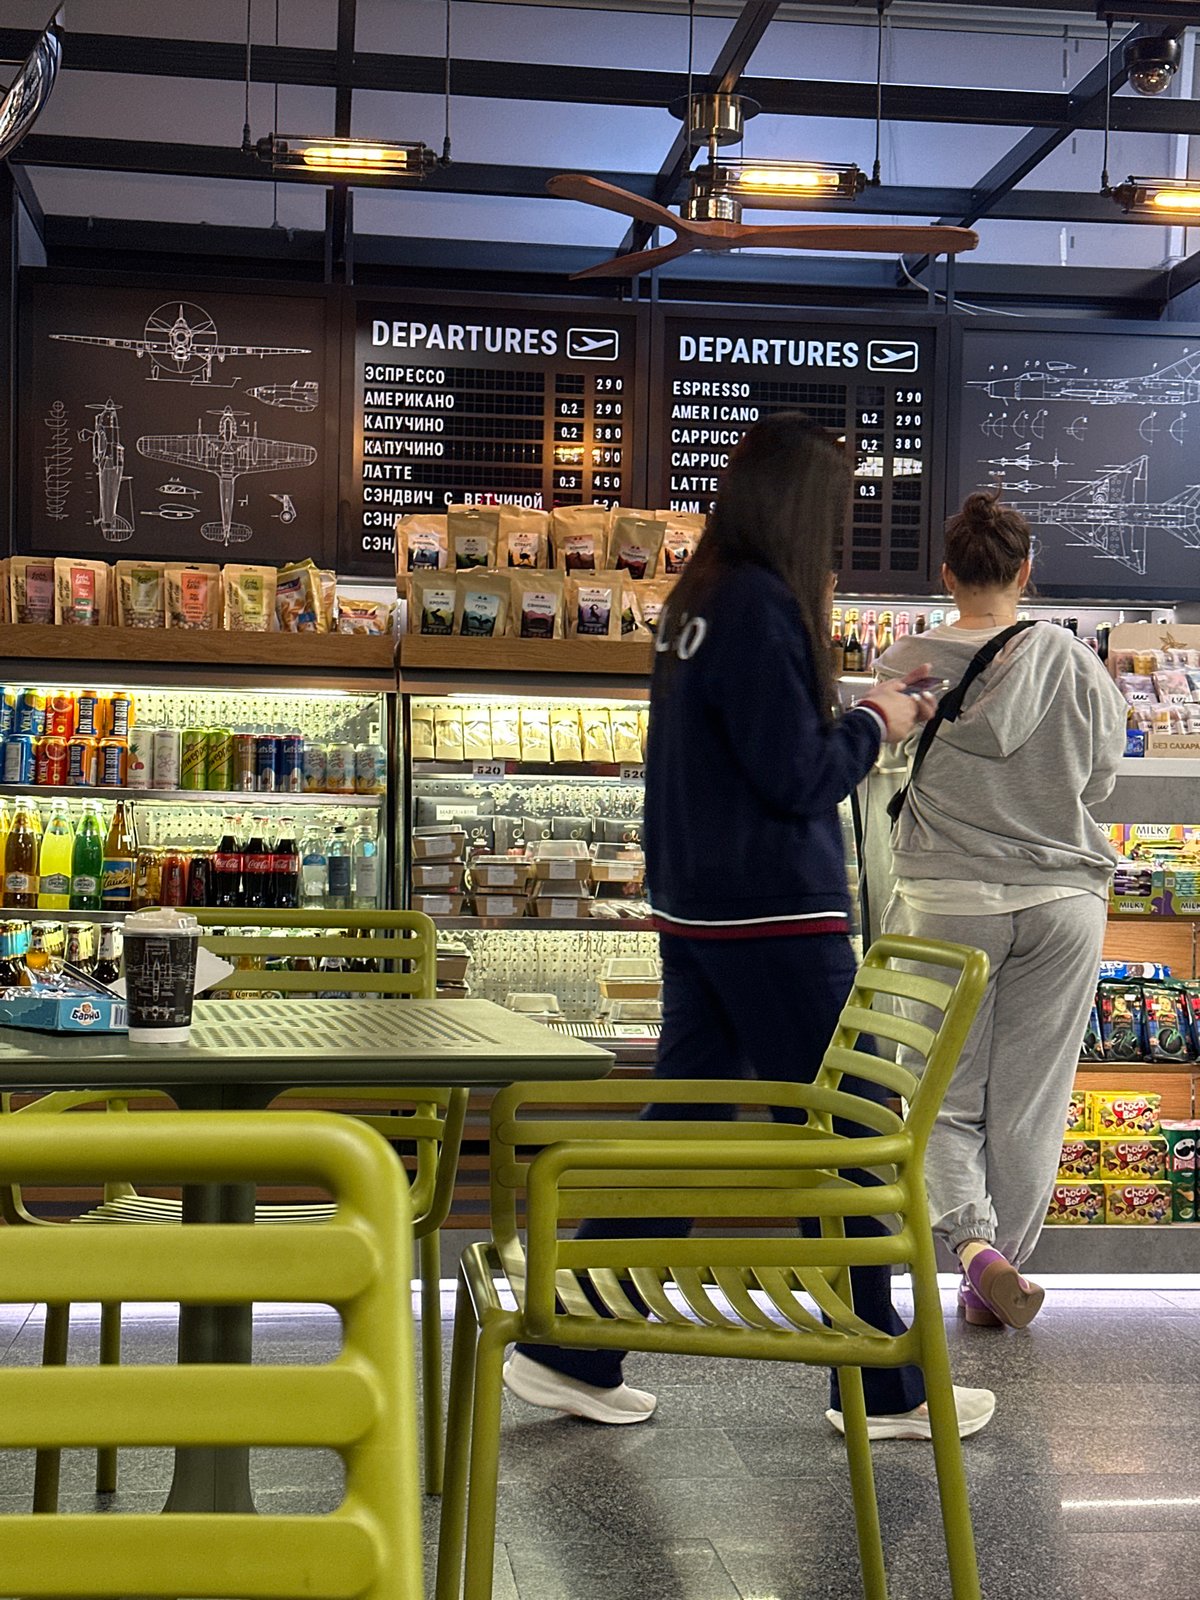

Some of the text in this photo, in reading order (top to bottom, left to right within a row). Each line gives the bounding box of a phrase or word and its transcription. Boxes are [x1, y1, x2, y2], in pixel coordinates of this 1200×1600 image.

[371, 320, 559, 356] DEPARTURES
[679, 335, 859, 369] DEPARTURES
[364, 366, 623, 391] ЭСПРЕССО 290
[364, 391, 622, 415] АМЕРИКАНО 0.2 290
[672, 380, 922, 404] ESPRESSO 290
[363, 414, 622, 439] КАПУЧИНО 0.2 380
[671, 404, 922, 427] AMERICANO 0.2 290
[363, 439, 445, 457] КАПУЧИНО
[861, 439, 878, 450] 0.2
[895, 438, 922, 449] 380
[363, 465, 620, 488] ЛАТТЕ 0.3 450
[671, 476, 876, 497] LATTE 0.3
[363, 487, 434, 506] СЭНДВИЧ
[463, 491, 544, 509] ВЕТЧИНОЙ
[1152, 742, 1200, 750] БЕЗ САХАРА
[477, 765, 501, 775] 520
[1136, 825, 1171, 834] MILKY
[71, 1009, 100, 1021] Барни
